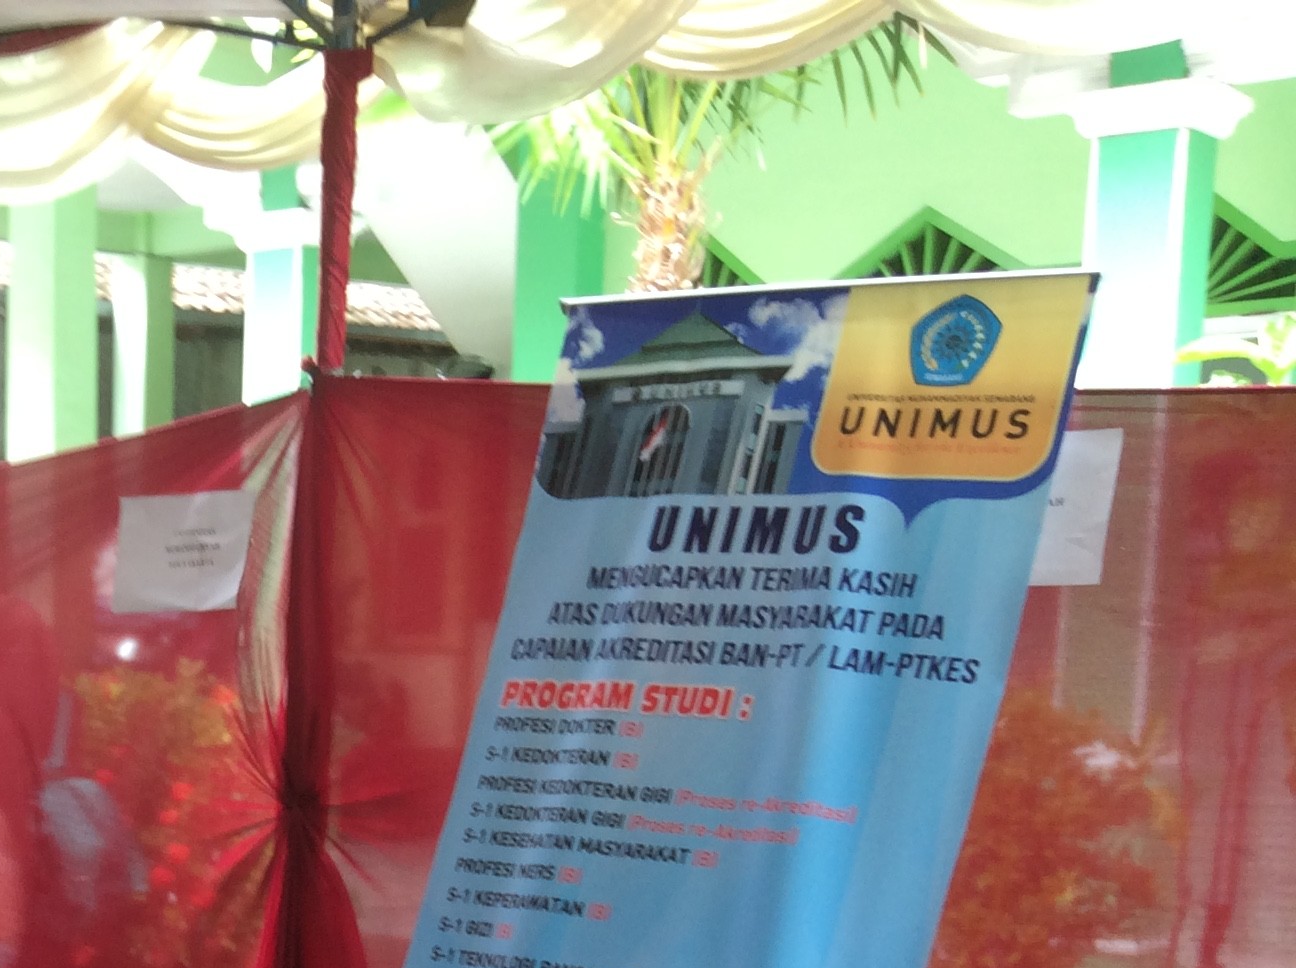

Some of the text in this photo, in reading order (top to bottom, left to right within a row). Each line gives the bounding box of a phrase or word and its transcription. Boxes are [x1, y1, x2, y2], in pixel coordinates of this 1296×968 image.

[840, 406, 1030, 439] UNIMUS
[648, 505, 866, 554] UNIMUS
[586, 564, 919, 598] MENGUCAPKAN TERIMA KASIH
[547, 601, 945, 641] ATAS DUKUNGAN MASYARAKAT PADA
[510, 637, 981, 685] CAPAIAN AKREDITASI BAN-PT / LAM-PTKES
[501, 679, 635, 711] PROGRAM
[639, 683, 734, 717] STUDI
[494, 716, 554, 734] PROFESI
[557, 717, 618, 735] DOKTER
[510, 747, 612, 767] KEDOKTERAN
[477, 775, 536, 794] PROFESI
[537, 776, 638, 801] KEDOKTERAN
[494, 804, 587, 824] KEDOKTERAN
[489, 830, 574, 851] KESEHATAN
[576, 836, 692, 864] MASYARAKAT
[455, 857, 515, 878] PROFESI
[473, 889, 586, 917] KEPERAWATAN
